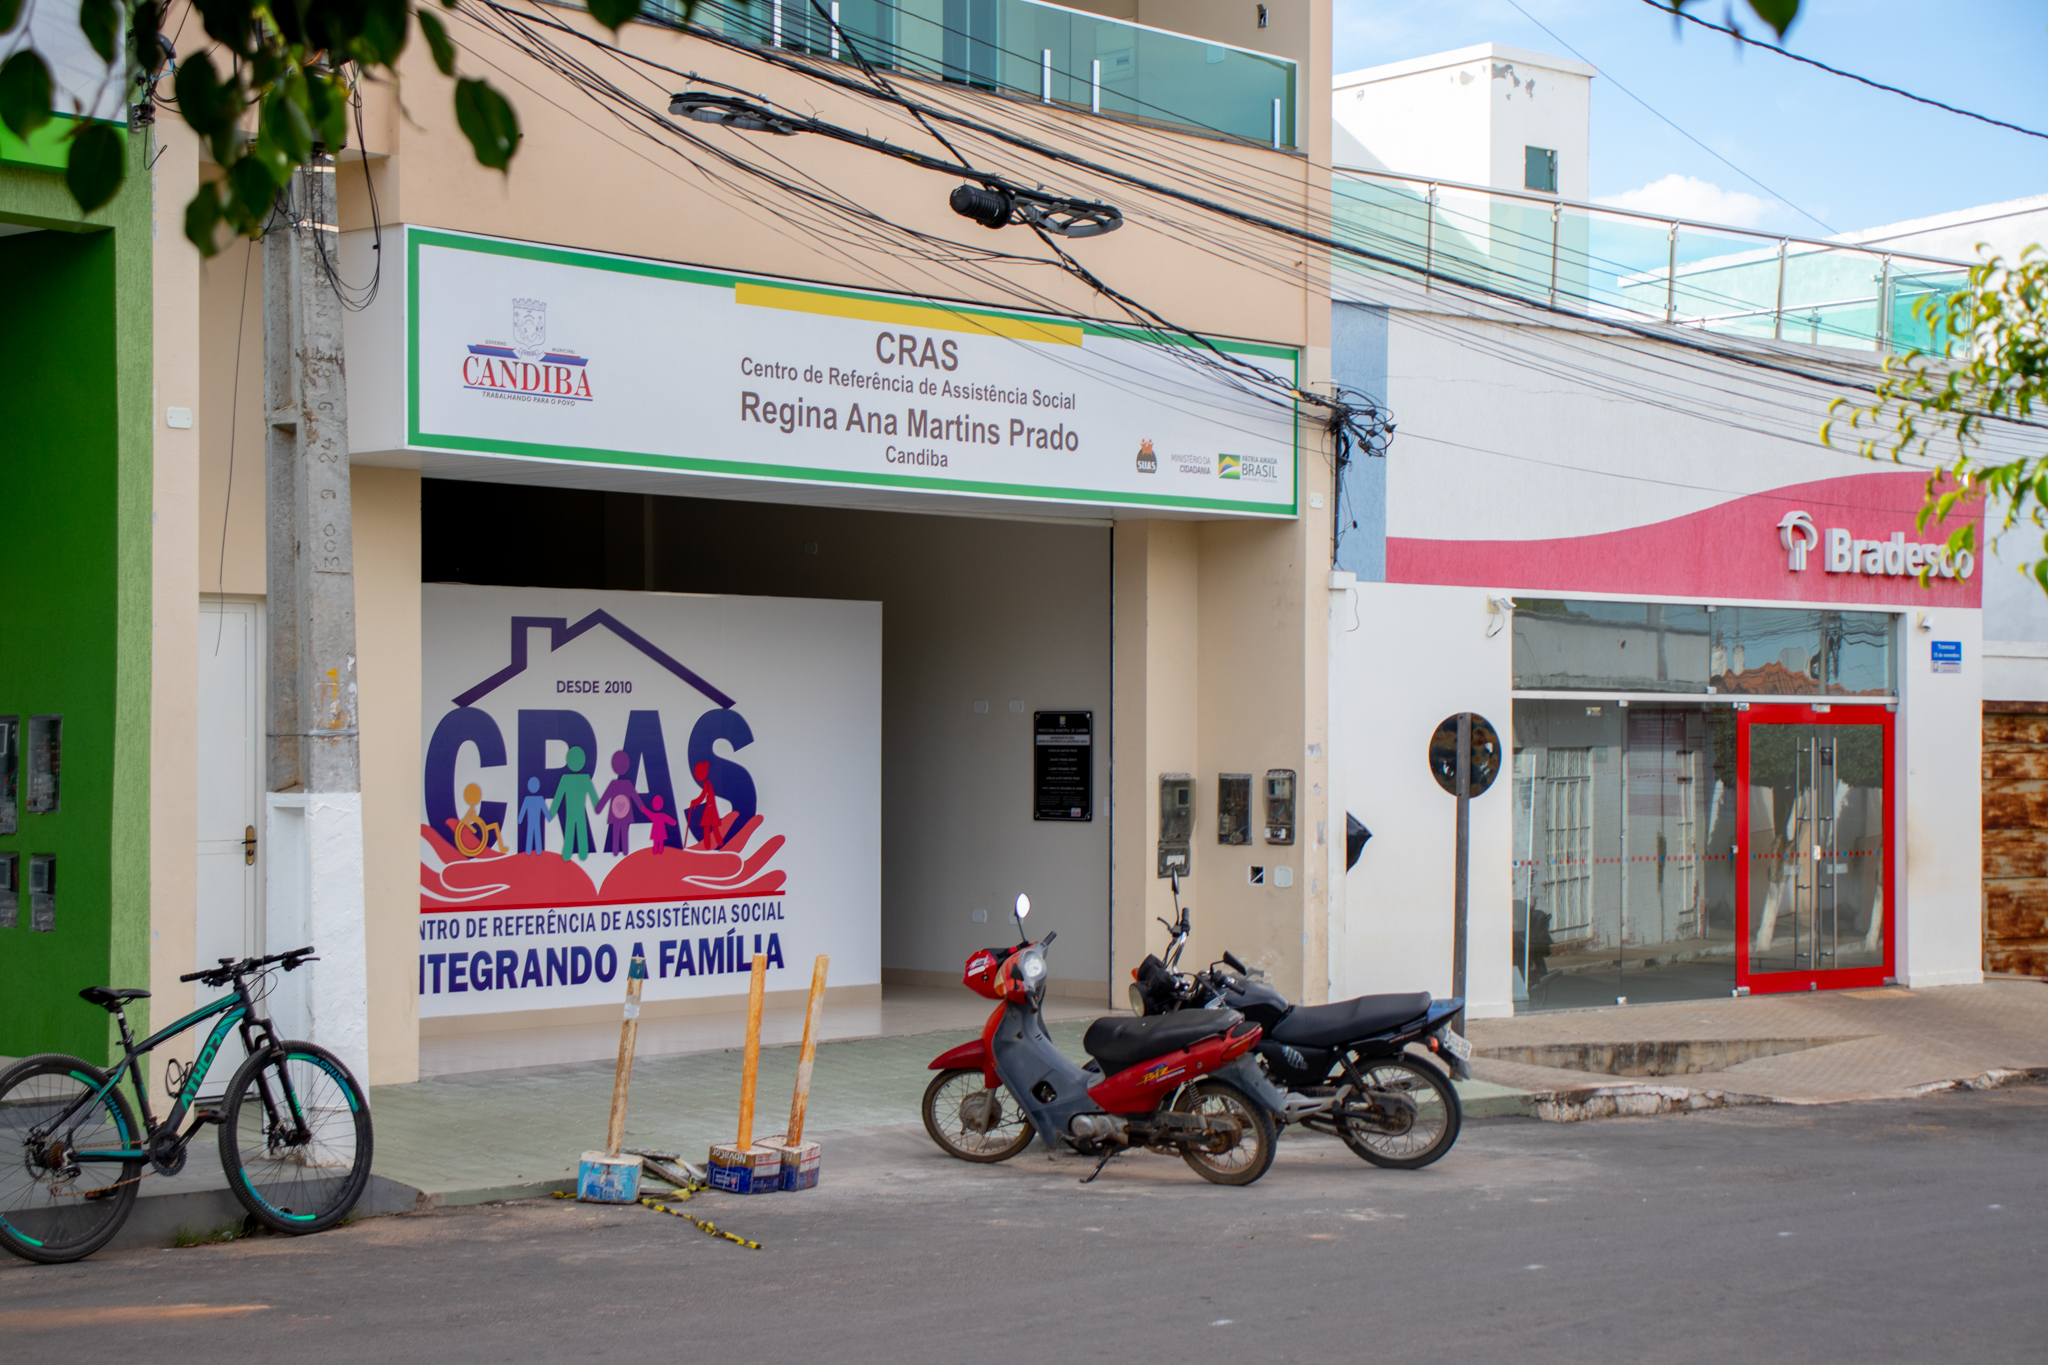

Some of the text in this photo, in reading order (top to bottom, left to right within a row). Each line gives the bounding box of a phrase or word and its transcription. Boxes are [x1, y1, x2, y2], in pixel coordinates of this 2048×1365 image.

[876, 331, 958, 371] CRAS
[463, 356, 593, 397] CANDIBA
[741, 357, 1076, 410] Centro de Referência de Assistência Social
[482, 391, 532, 402] TRABALHANDO
[557, 399, 575, 407] POVO
[741, 391, 1079, 452] Regina Ana Martins Prado
[885, 445, 948, 467] Candiba
[1137, 460, 1157, 470] SUAS
[1171, 453, 1211, 465] MINISTÉRIO DA
[1179, 464, 1211, 475] CIDADANIA
[1242, 454, 1278, 465] PÁTRIA AMADA
[1242, 463, 1278, 478] BRASIL
[1825, 528, 1974, 579] Bradesco
[556, 680, 633, 694] DESDE 2010
[424, 706, 757, 859] CRAS
[466, 917, 488, 938] DE
[493, 908, 596, 937] REFERÊNCIA
[601, 911, 621, 931] DE
[625, 901, 727, 930] ASSISTÊNCIA
[731, 901, 785, 923] SOCIAL
[419, 943, 618, 995] TEGRANDO
